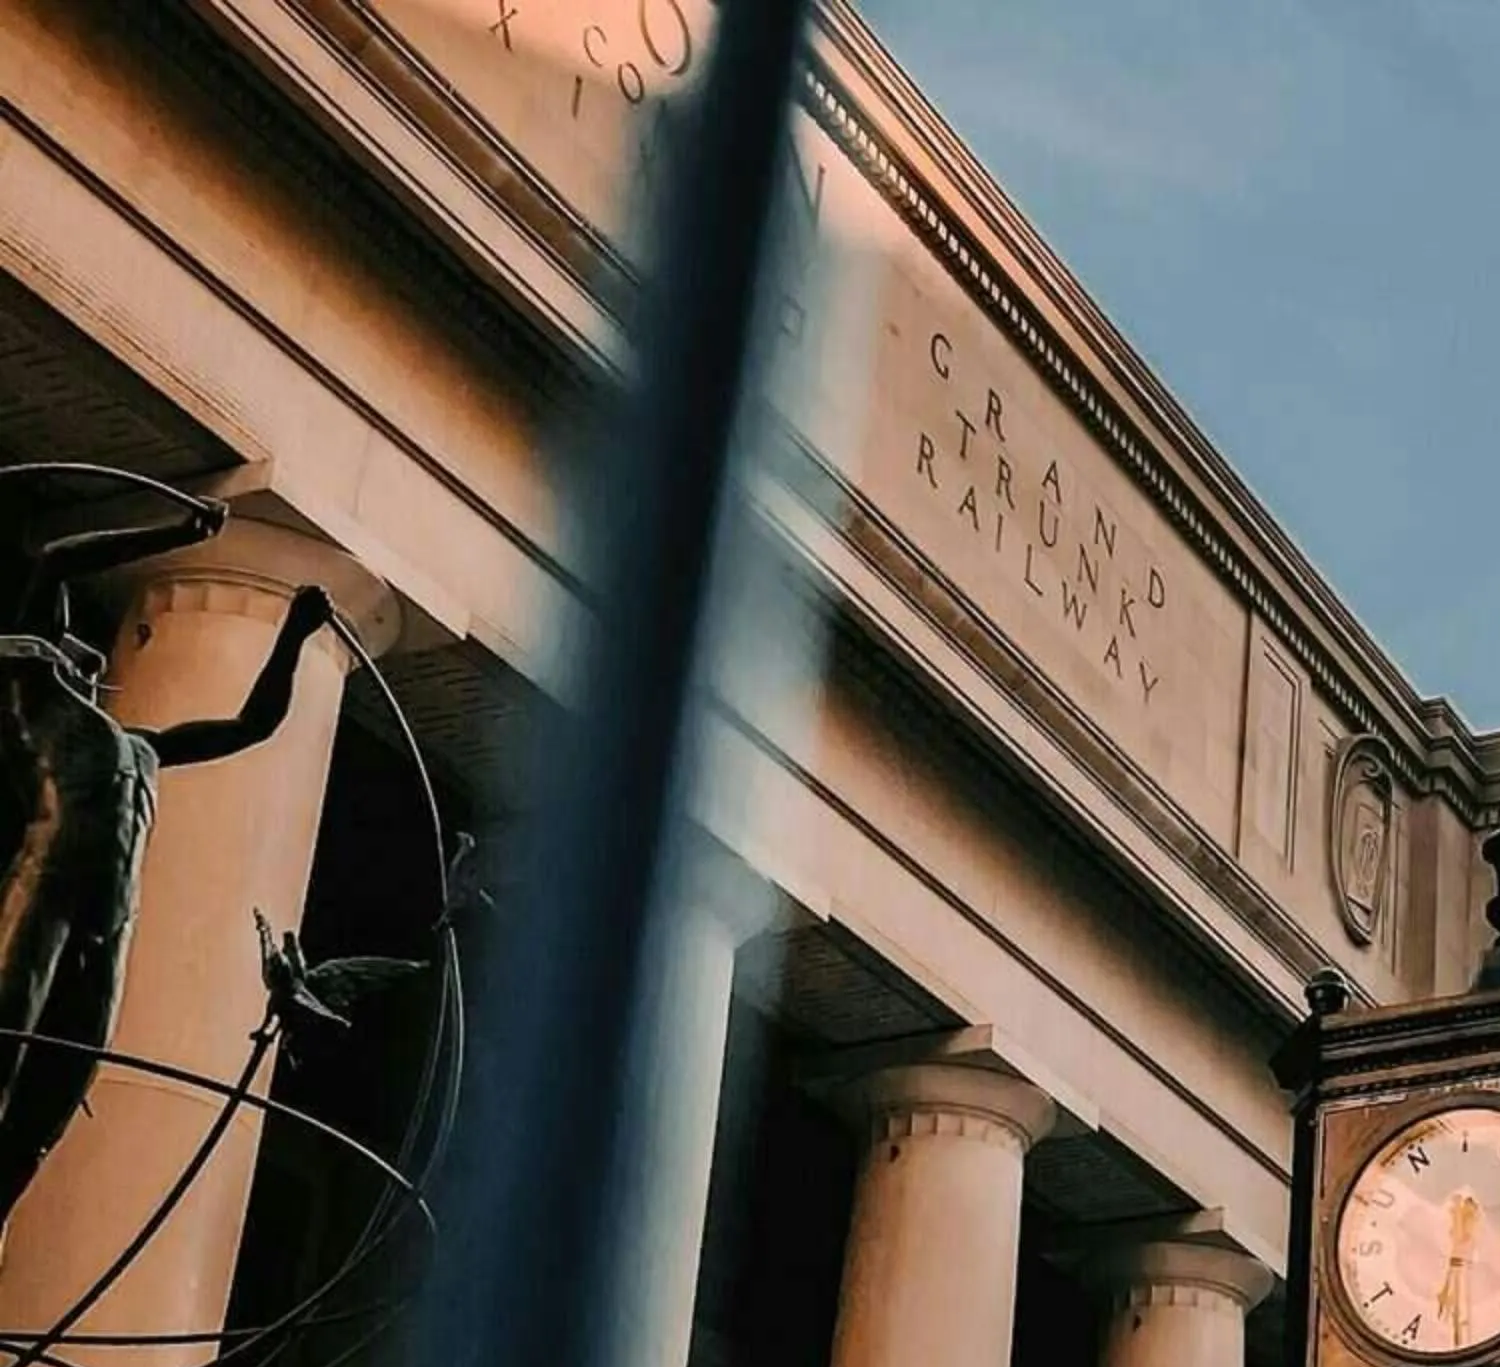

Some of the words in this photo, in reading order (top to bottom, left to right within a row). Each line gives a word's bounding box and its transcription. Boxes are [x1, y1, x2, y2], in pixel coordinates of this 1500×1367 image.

[916, 431, 1159, 703] RAILWAY
[929, 332, 1166, 609] GRAND
[955, 409, 1137, 639] TRUNK
